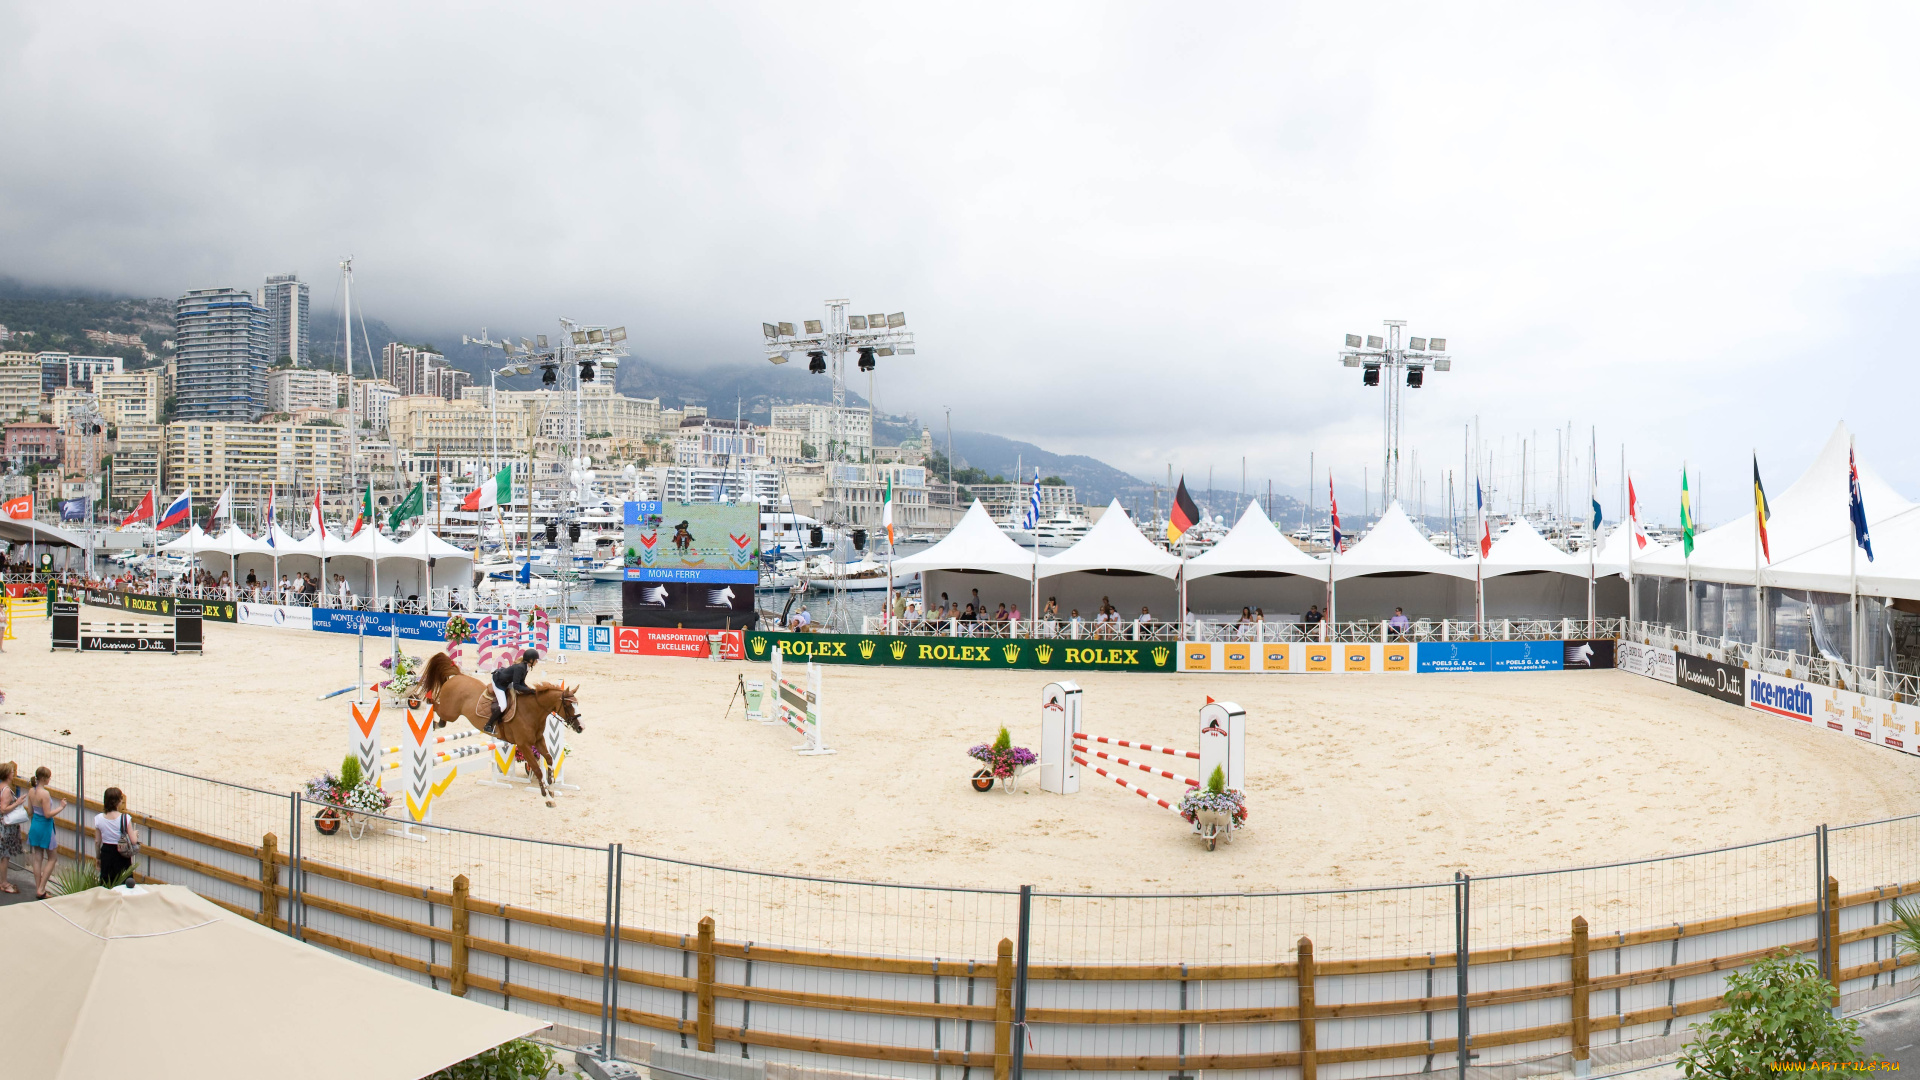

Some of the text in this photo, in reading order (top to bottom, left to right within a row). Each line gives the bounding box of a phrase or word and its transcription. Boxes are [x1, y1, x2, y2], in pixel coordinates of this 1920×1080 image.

[636, 503, 655, 512] 19.9
[648, 570, 673, 578] MONA
[676, 571, 700, 579] FERRY
[86, 590, 108, 602] Massimo
[132, 598, 158, 612] ROLEX
[567, 628, 579, 640] SAI
[595, 629, 608, 642] SAI
[90, 638, 166, 650] Massimo Dutti
[620, 640, 639, 648] CN
[656, 643, 700, 651] EXCELLENCE
[779, 640, 847, 657] ROLEX
[918, 644, 990, 661] ROLEX
[1065, 648, 1139, 665] ROLEX
[1678, 658, 1715, 688] Massimo
[1717, 668, 1742, 696] Dutti
[1750, 673, 1812, 715] nice-matin
[1825, 699, 1845, 717] Bitburger
[1852, 706, 1874, 725] Bitburger
[1883, 713, 1905, 733] Bitburger
